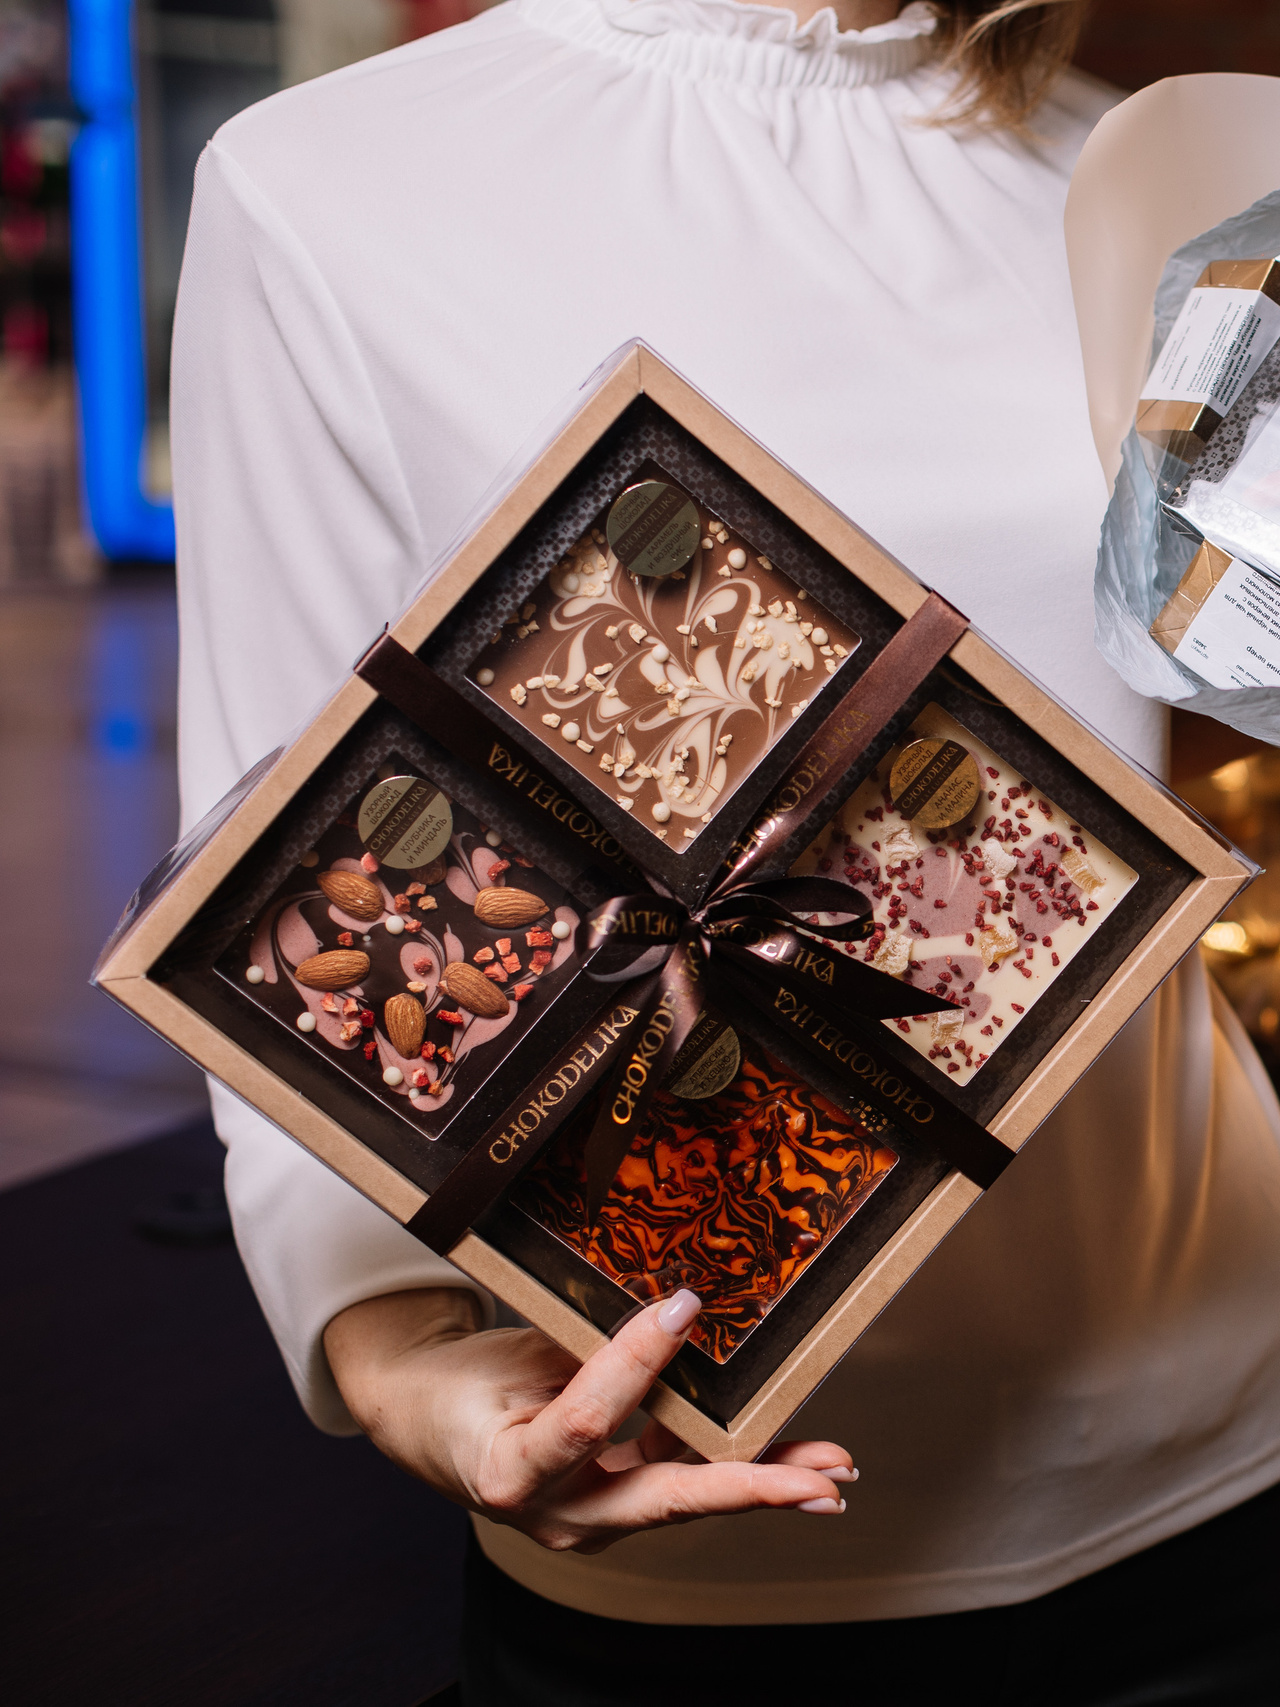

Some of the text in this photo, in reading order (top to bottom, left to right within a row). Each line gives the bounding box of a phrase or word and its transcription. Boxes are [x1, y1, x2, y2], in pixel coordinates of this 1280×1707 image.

[612, 489, 642, 522] УЗОРНЫЙ
[616, 490, 676, 557] CHOKODELIKA
[618, 494, 651, 530] ШОКОЛАД
[646, 520, 679, 556] КАРАМЕЛЬ
[653, 520, 692, 564] ВОЗДУШНЫЙ
[670, 543, 685, 560] РИС
[1223, 592, 1236, 604] для
[1237, 583, 1280, 617] апельсиновых
[1243, 576, 1276, 601] молочного
[1234, 602, 1247, 613] чай
[1246, 599, 1272, 620] вечеров
[1245, 644, 1267, 663] вечер
[896, 744, 924, 776] УЗОРНЫЙ
[900, 744, 957, 810] CHOKODELIKA
[902, 749, 933, 784] ШОКОЛАД
[362, 785, 392, 818] УЗОРНЫЙ
[369, 789, 401, 825] ШОКОЛАД
[723, 704, 870, 874] CHOKODELIKA
[933, 776, 962, 809] АНАНАС
[938, 779, 974, 820] И МАЛИНА
[368, 784, 427, 851] CHOKODELIKA
[400, 813, 436, 853] КЛУБНИКА
[406, 816, 448, 864] И МИНДАЛЬ
[688, 1045, 725, 1084] АПЕЛЬСИН
[698, 1054, 731, 1089] И КЕШЬЮ
[773, 986, 936, 1125] CHOKODELIKA
[487, 1006, 639, 1164] CHOKODELIKA
